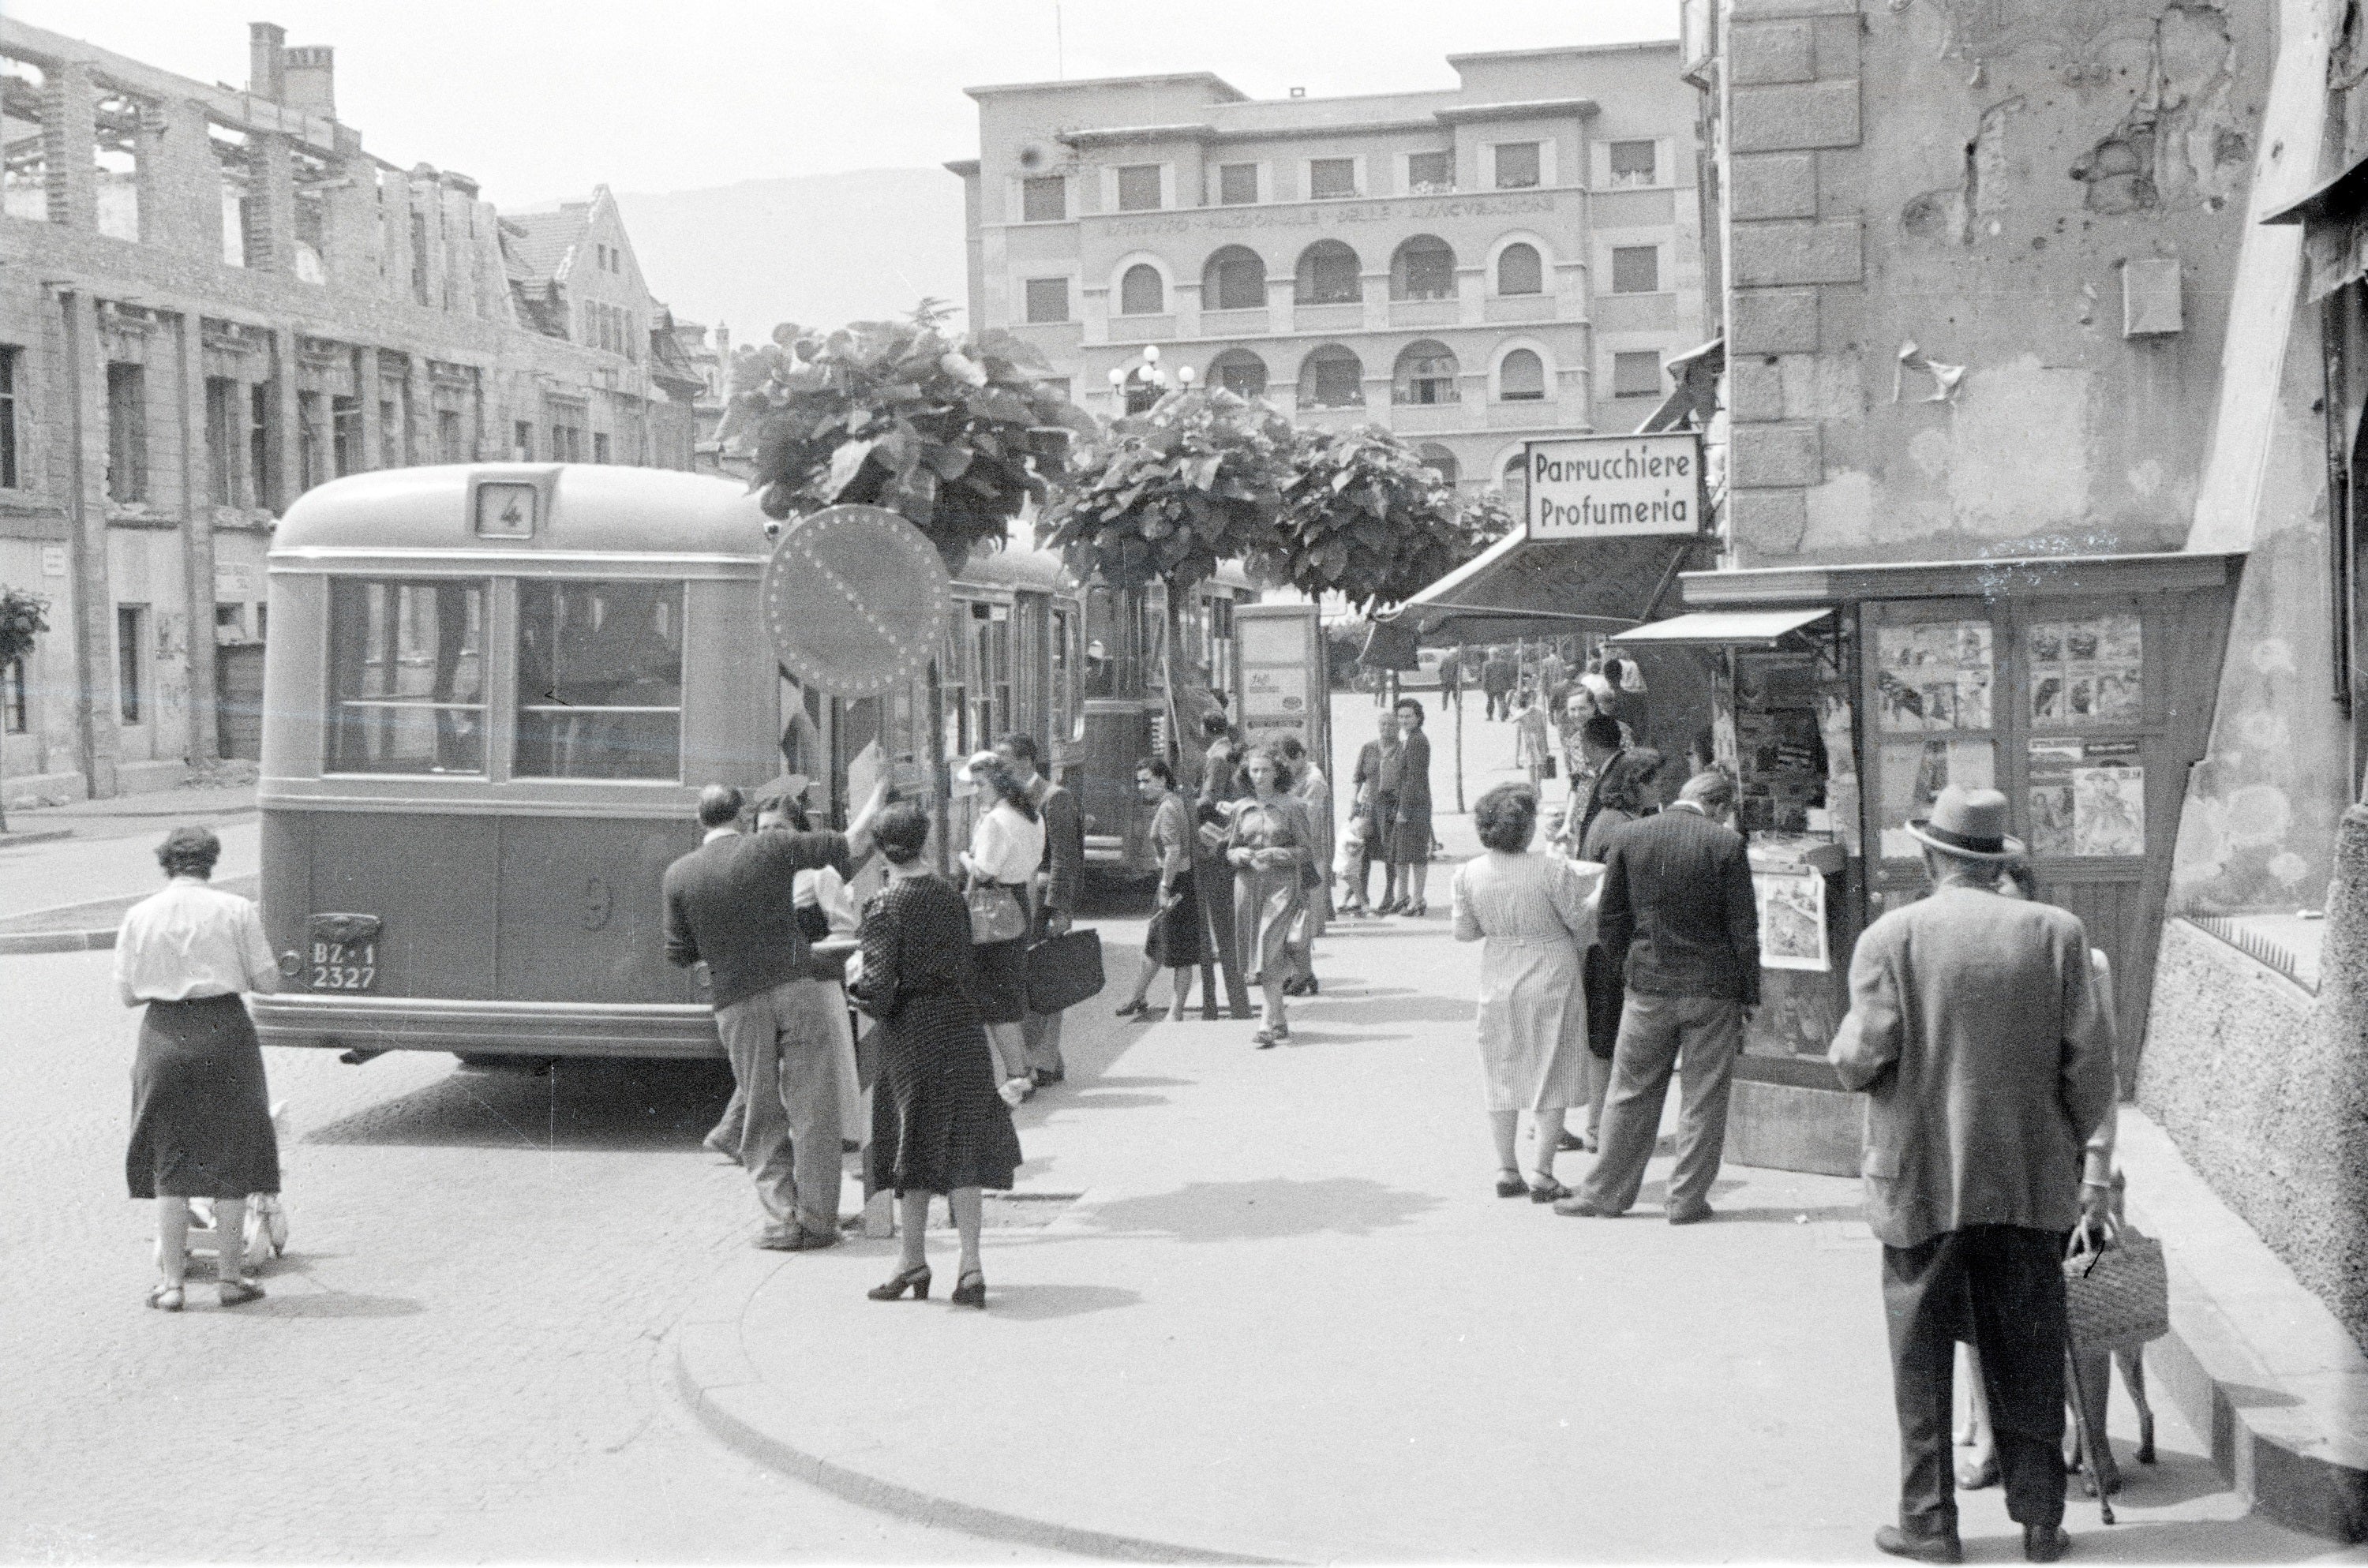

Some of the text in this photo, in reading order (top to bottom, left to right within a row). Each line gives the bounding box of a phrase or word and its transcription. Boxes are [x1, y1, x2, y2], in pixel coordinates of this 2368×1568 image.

[1536, 445, 1689, 483] Parrucchiere
[500, 490, 522, 526] 4
[1542, 488, 1687, 526] Profumeria
[314, 967, 375, 988] 2327
